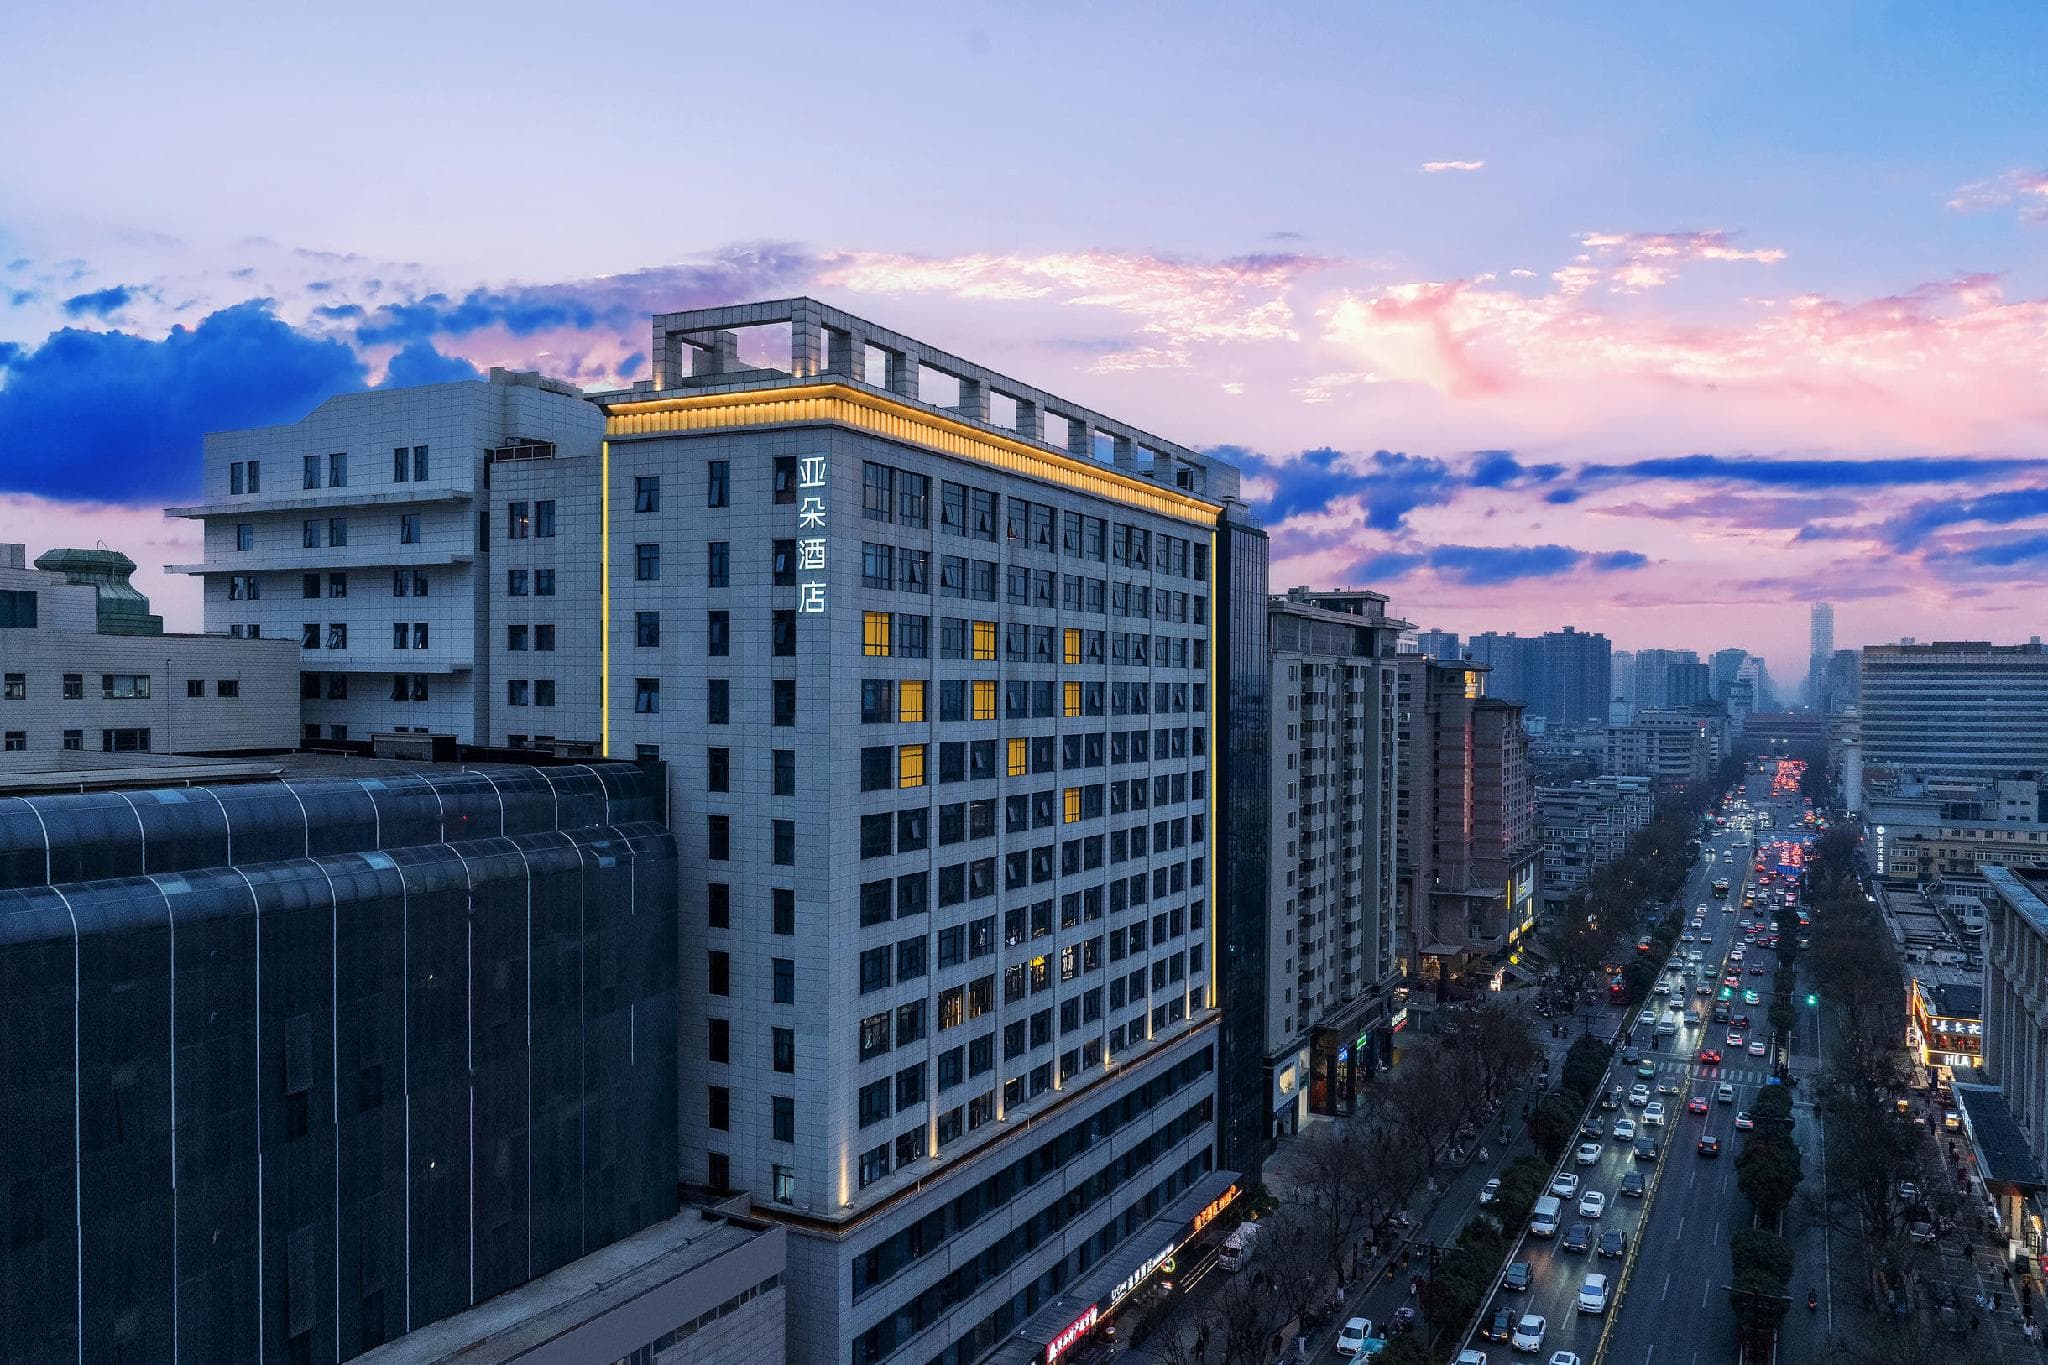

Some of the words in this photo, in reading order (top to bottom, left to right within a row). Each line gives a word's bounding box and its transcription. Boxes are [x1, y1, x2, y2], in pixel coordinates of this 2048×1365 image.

[799, 456, 826, 613] 亚朵酒店
[1945, 1054, 1970, 1067] HLA
